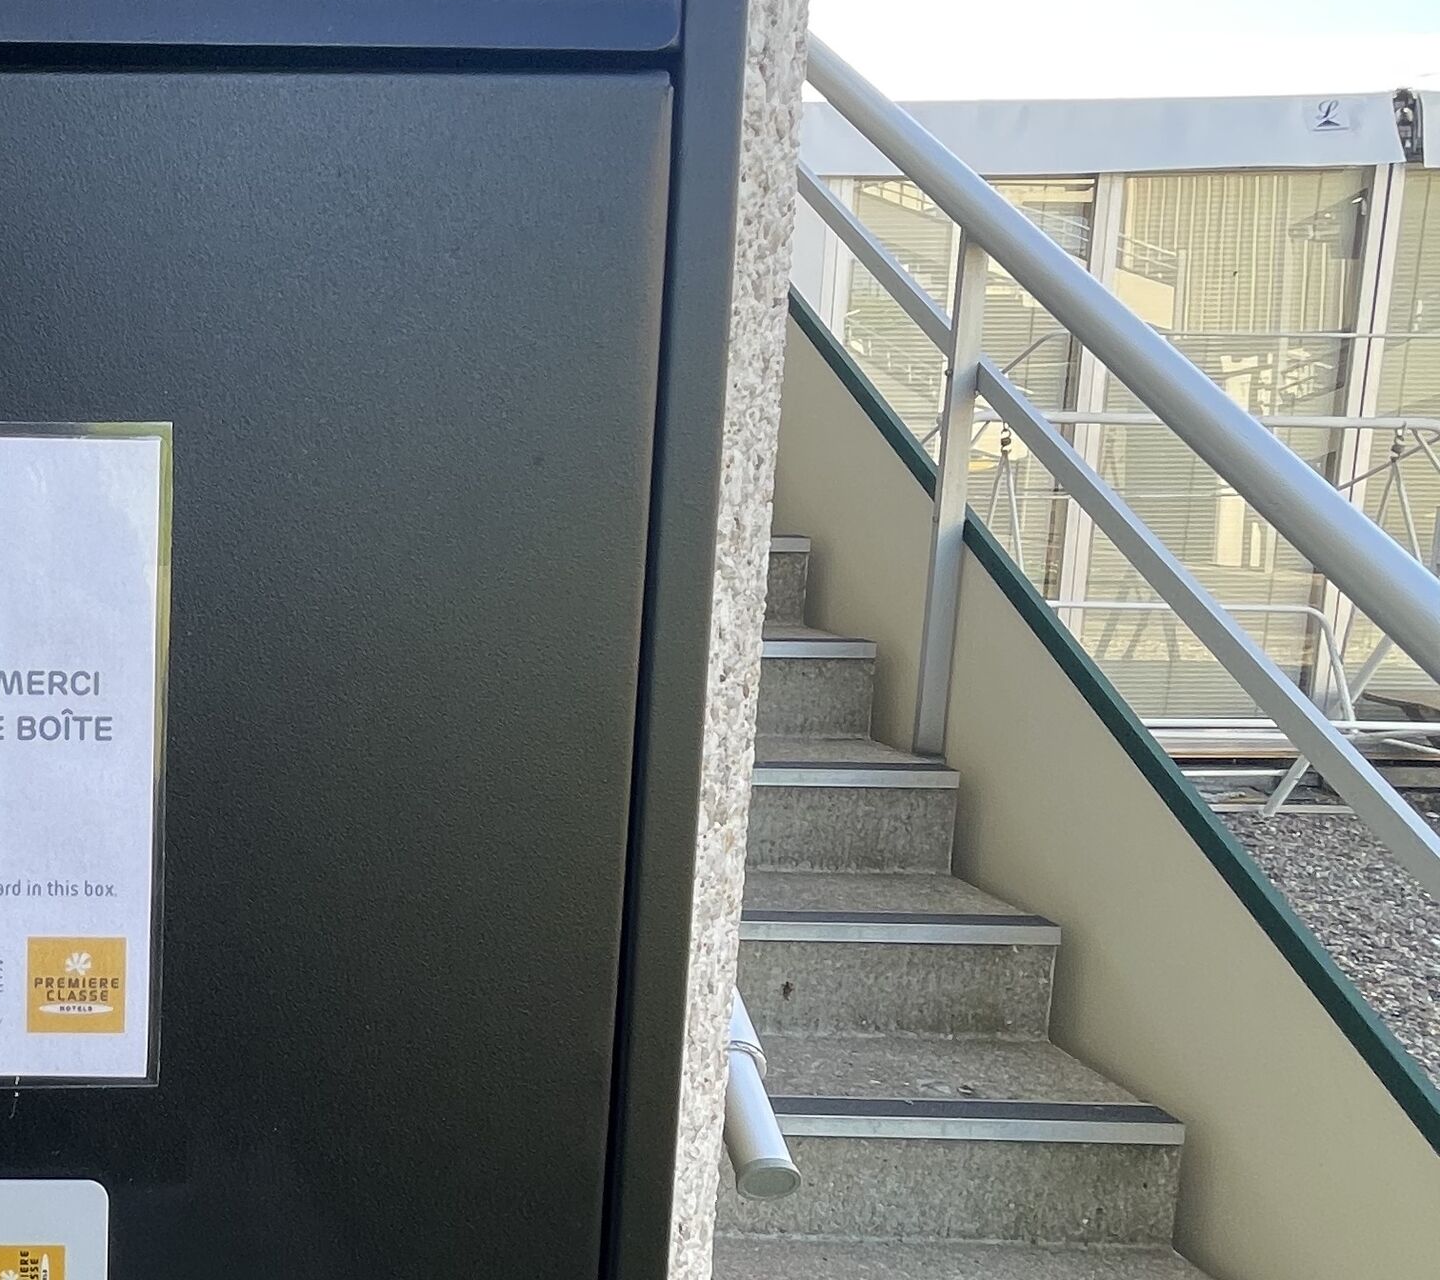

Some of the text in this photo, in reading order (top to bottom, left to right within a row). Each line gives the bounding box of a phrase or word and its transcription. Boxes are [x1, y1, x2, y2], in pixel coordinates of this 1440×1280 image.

[17, 708, 112, 741] BOÎTE
[27, 880, 42, 896] in
[47, 880, 79, 897] this
[84, 880, 118, 897] box.
[34, 977, 120, 989] PREMIERE
[46, 990, 109, 1001] CLASSE
